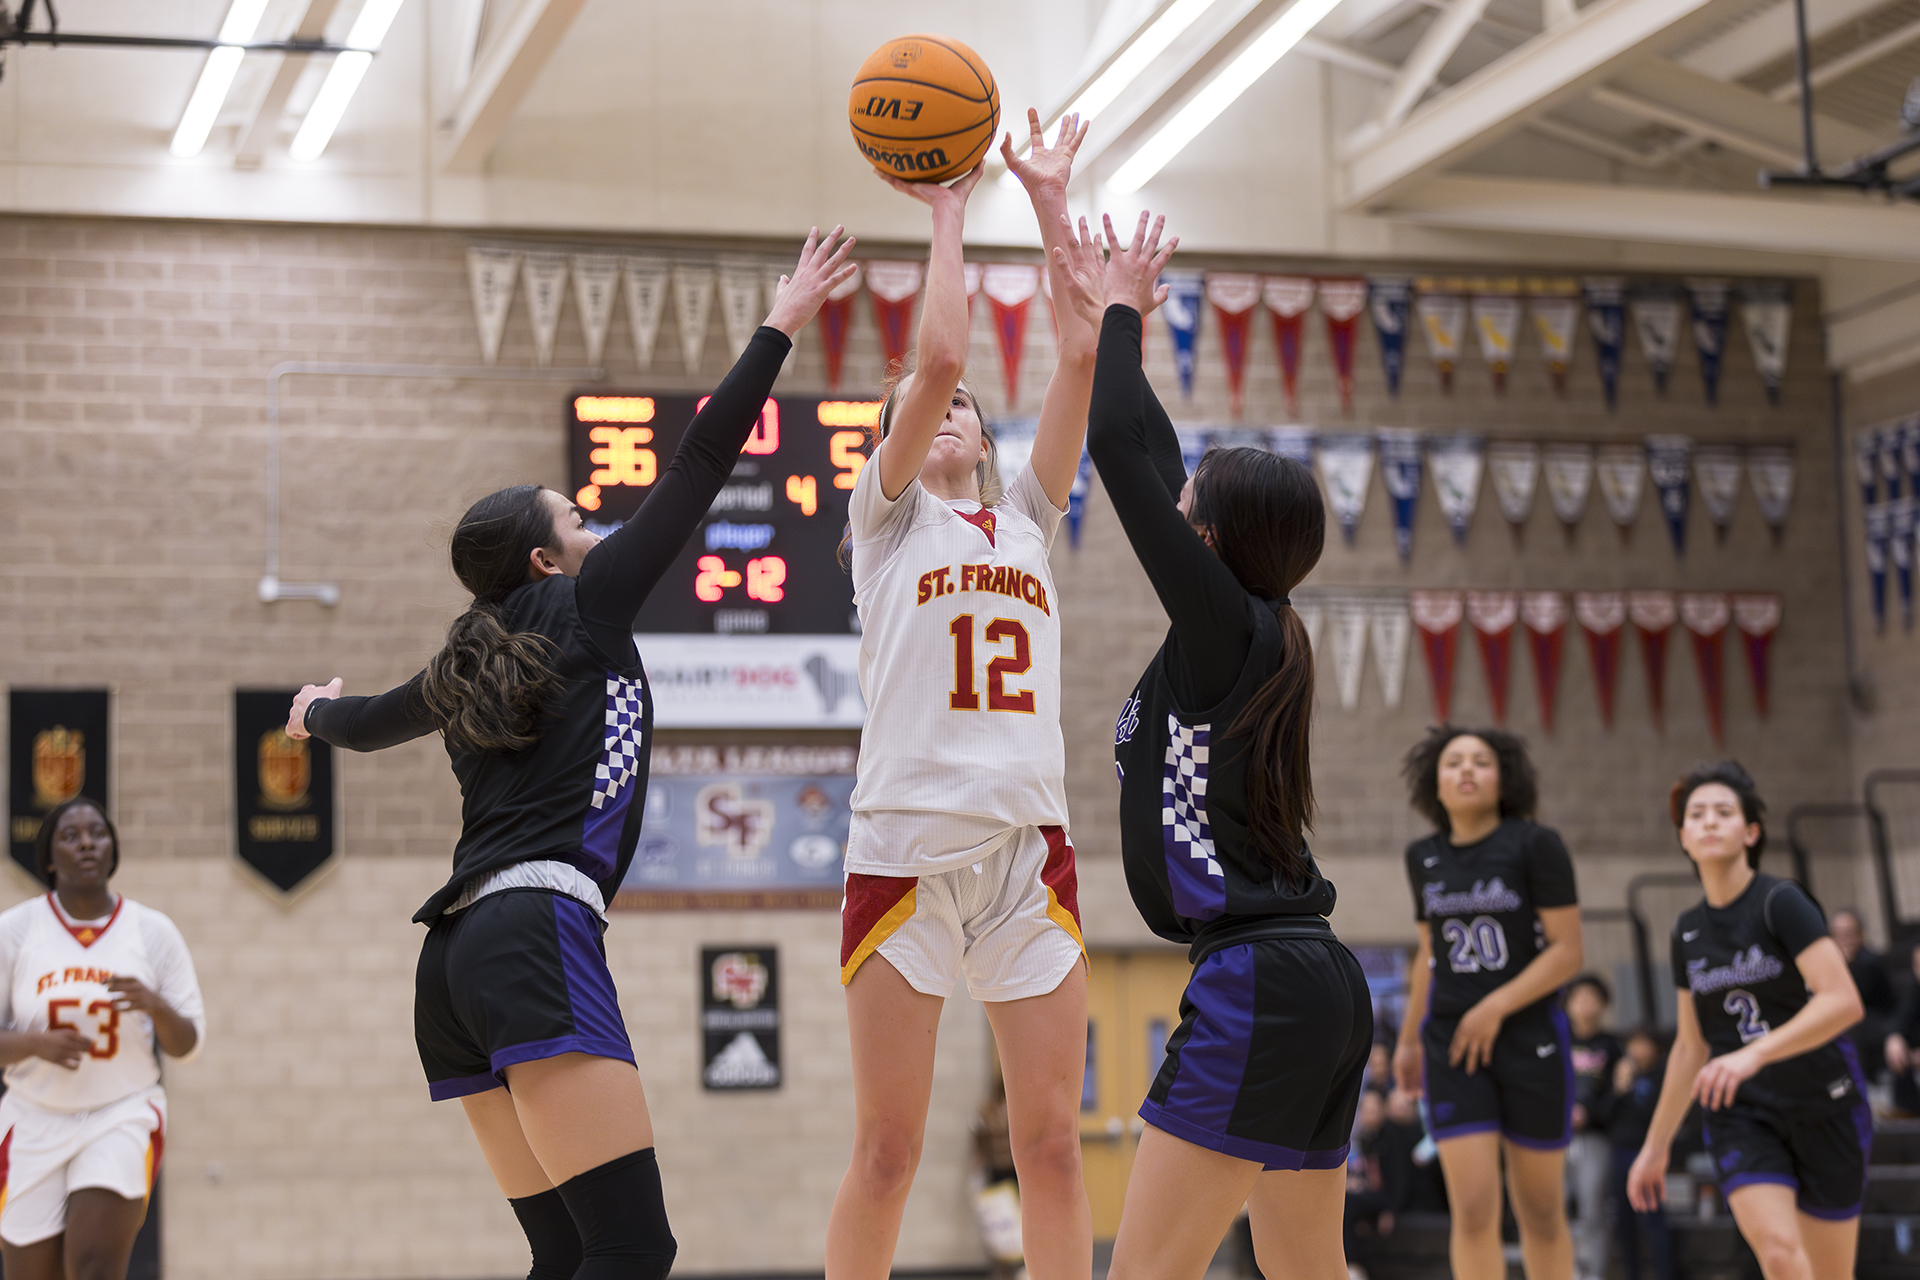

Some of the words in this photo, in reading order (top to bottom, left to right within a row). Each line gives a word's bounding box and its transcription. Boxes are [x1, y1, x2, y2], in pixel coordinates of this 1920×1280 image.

[866, 97, 923, 121] EVO
[855, 135, 951, 172] Wilson
[589, 427, 657, 486] 36
[786, 475, 817, 516] 4
[917, 564, 955, 607] ST.
[949, 613, 1036, 715] 12
[1442, 915, 1509, 973] 20
[48, 998, 120, 1061] 53
[1723, 989, 1771, 1043] 2
